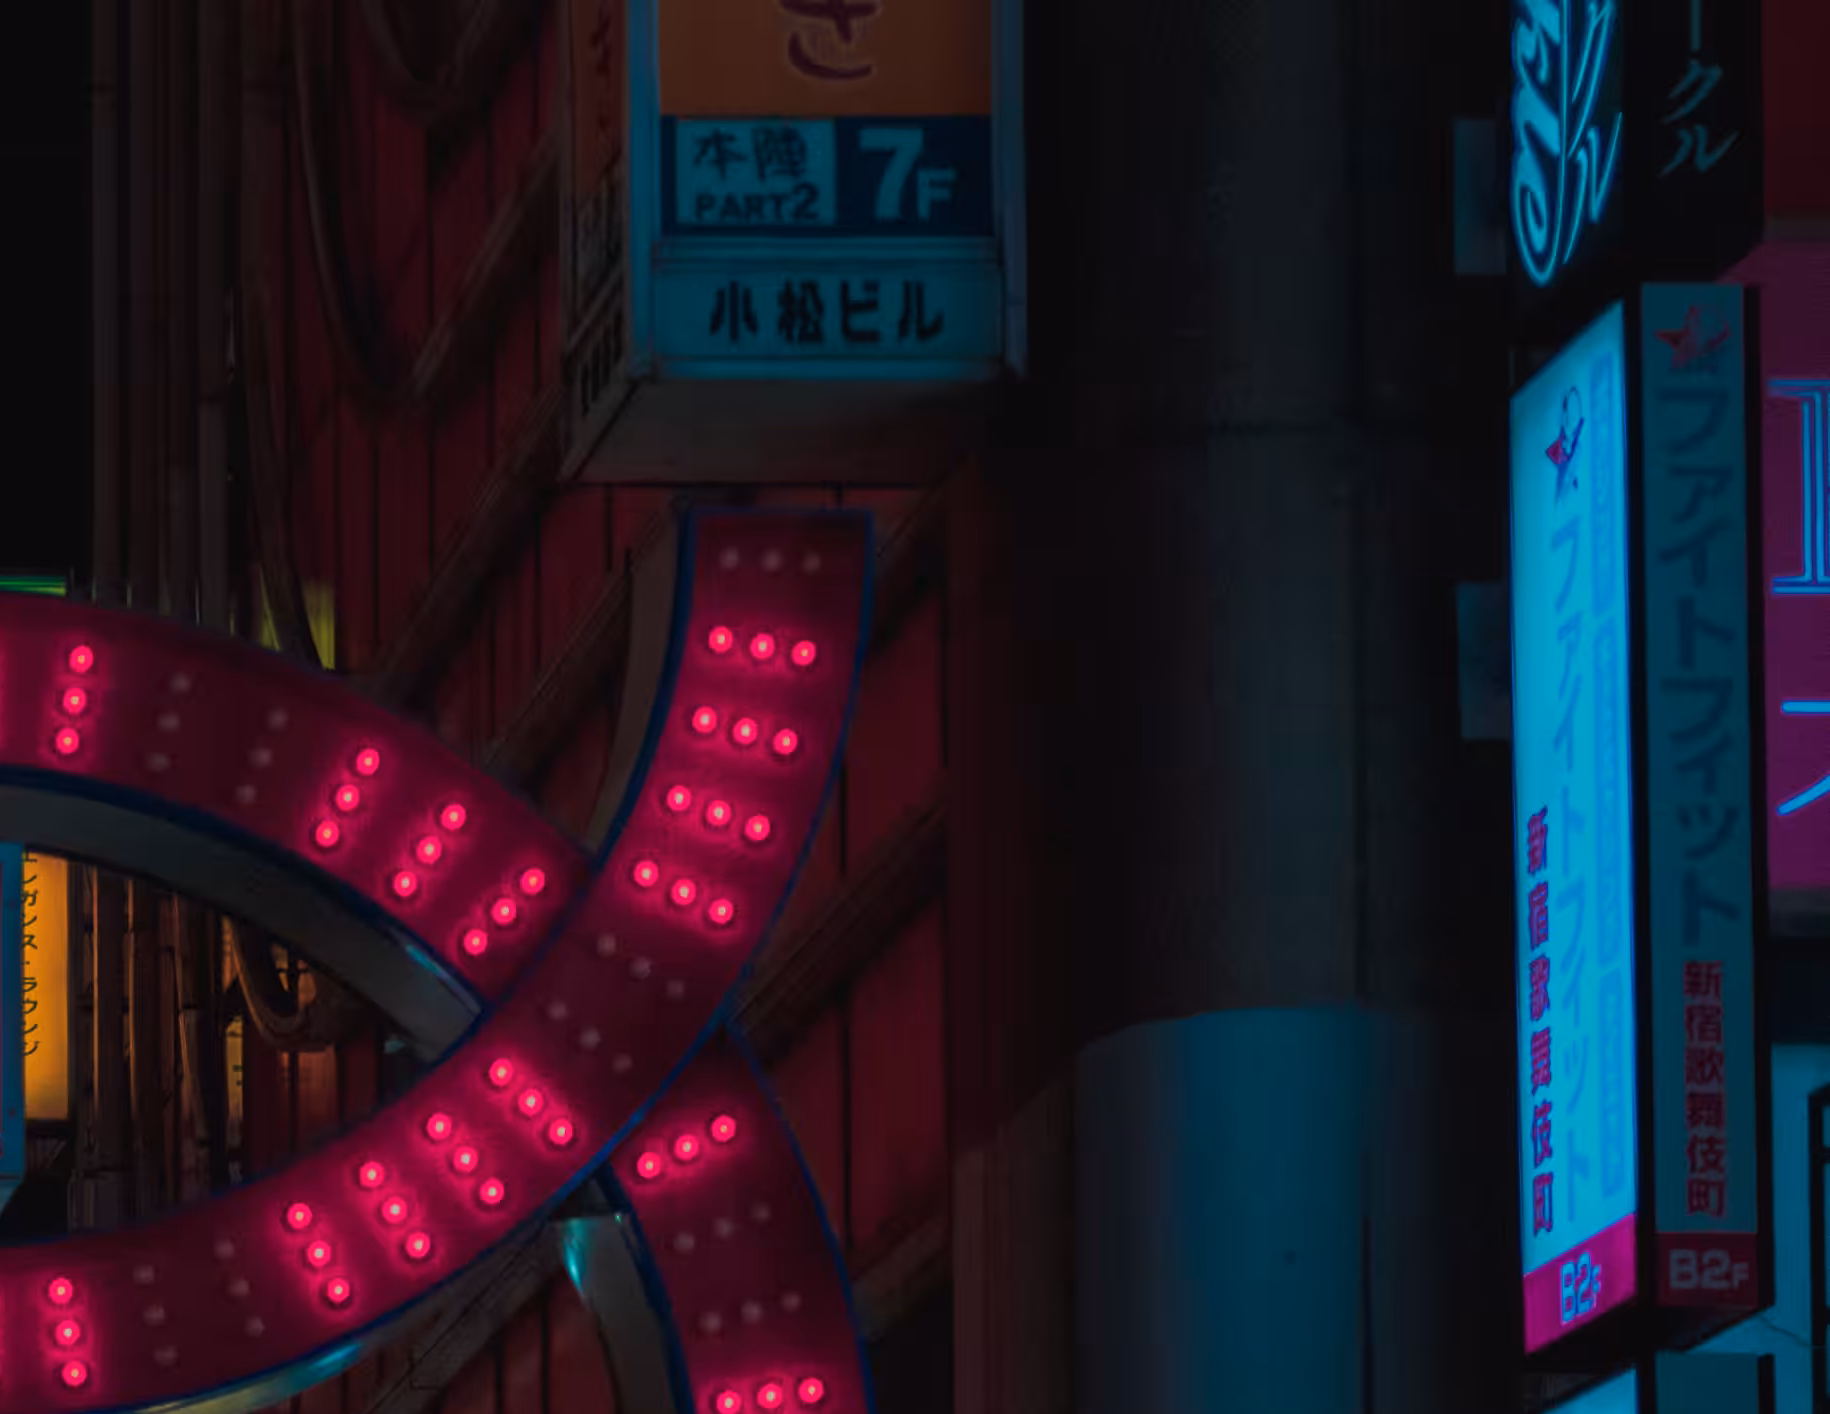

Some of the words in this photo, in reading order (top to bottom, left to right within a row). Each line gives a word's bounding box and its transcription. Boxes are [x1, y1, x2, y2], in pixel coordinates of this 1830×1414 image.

[695, 185, 820, 221] PART2
[857, 126, 958, 222] 7F
[709, 280, 945, 343] 小松ビル
[1683, 959, 1726, 1219] 新宿歌舞伎町
[1561, 1252, 1602, 1326] B2F
[1668, 1247, 1750, 1291] B2F
